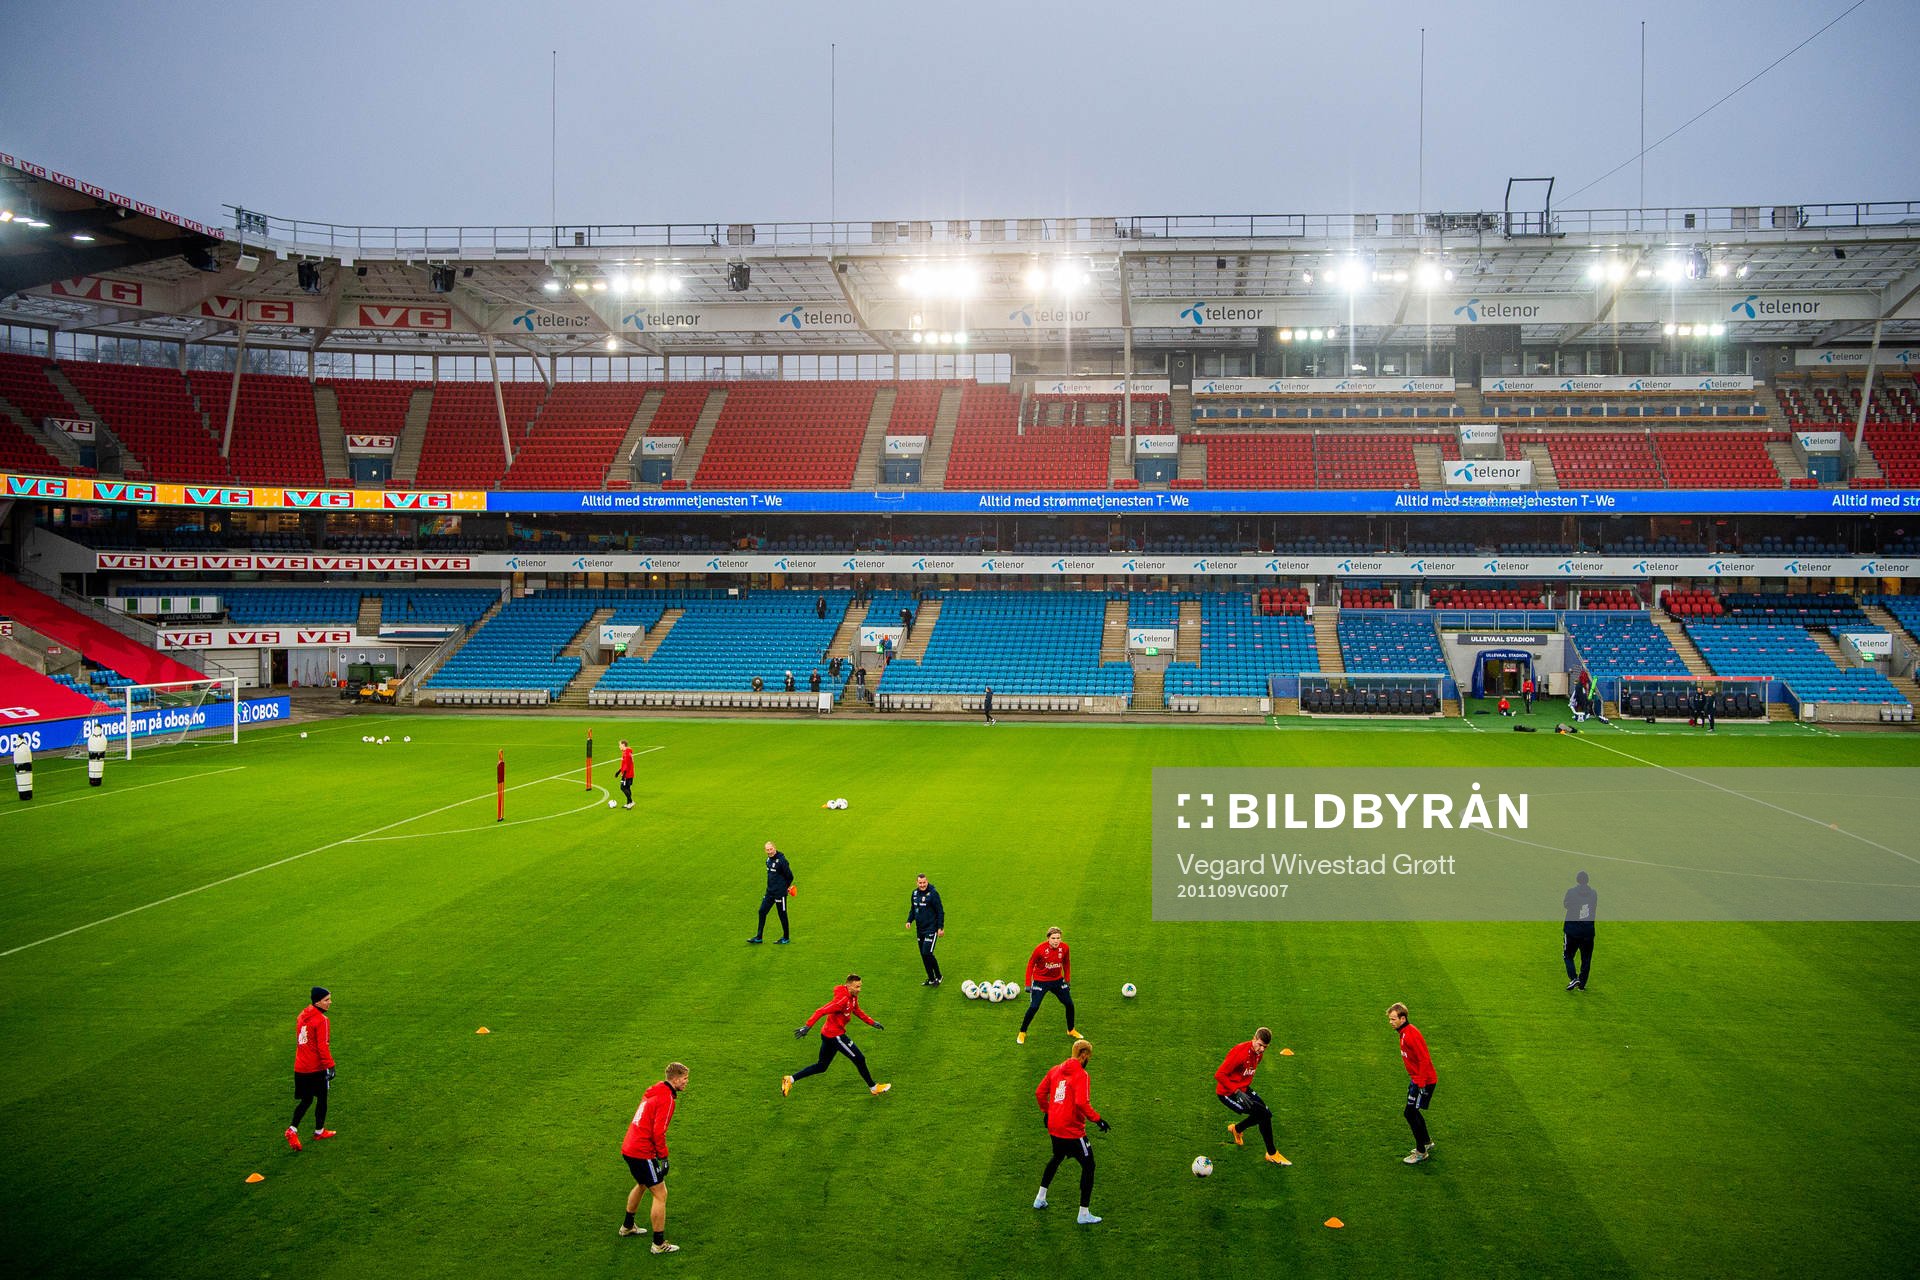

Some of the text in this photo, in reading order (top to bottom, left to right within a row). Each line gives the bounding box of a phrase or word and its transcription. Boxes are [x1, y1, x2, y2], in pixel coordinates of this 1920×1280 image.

[21, 160, 45, 177] VG
[53, 171, 76, 188] VG
[82, 182, 104, 199] VG
[110, 192, 130, 208] VG
[136, 202, 155, 216] VG
[161, 210, 179, 225] VG
[184, 218, 202, 232] VG
[207, 227, 224, 239] VG
[60, 277, 137, 304] VG
[206, 297, 289, 322] VG
[1480, 303, 1540, 318] telenor
[1759, 299, 1821, 314] telenor
[362, 306, 447, 328] VG
[535, 313, 590, 327] telenor
[647, 312, 701, 326] telenor
[1034, 308, 1091, 322] telenor
[1205, 306, 1263, 321] telenor
[1832, 352, 1863, 361] telenor
[1214, 383, 1244, 391] telenor
[1280, 382, 1310, 391] telenor
[1414, 381, 1443, 390] telenor
[1504, 379, 1741, 390] telenor telenor telenor telenor
[56, 420, 91, 435] VG
[1471, 430, 1498, 439] telenor
[348, 436, 393, 449] VG
[655, 441, 679, 449] telenor
[899, 440, 924, 448] telenor
[1150, 440, 1175, 448] telenor
[1809, 438, 1837, 447] telenor
[1473, 466, 1520, 479] telenor
[8, 478, 450, 508] VG VG VG VG VG
[581, 495, 782, 508] Alltid med strømmetjenesten T-We
[979, 495, 1189, 508] Alltid med strømmetjenesten T-We
[1395, 494, 1427, 506] Alltid
[1432, 494, 1459, 506] med
[1581, 494, 1615, 506] T-We
[1832, 494, 1920, 506] Alltid med str
[101, 556, 468, 570] VG VG VG VG VG VG VG
[518, 559, 1910, 571] telenor telenor telenor telenor telenor telenor telenor telenor telenor telenor telenor telenor telenor telenor telenor telenor telenor telenor telenor telenor
[165, 631, 350, 645] VG VG VG
[875, 632, 901, 640] telnor
[252, 703, 279, 720] OBOS
[102, 716, 146, 735] medem
[149, 712, 162, 735] på
